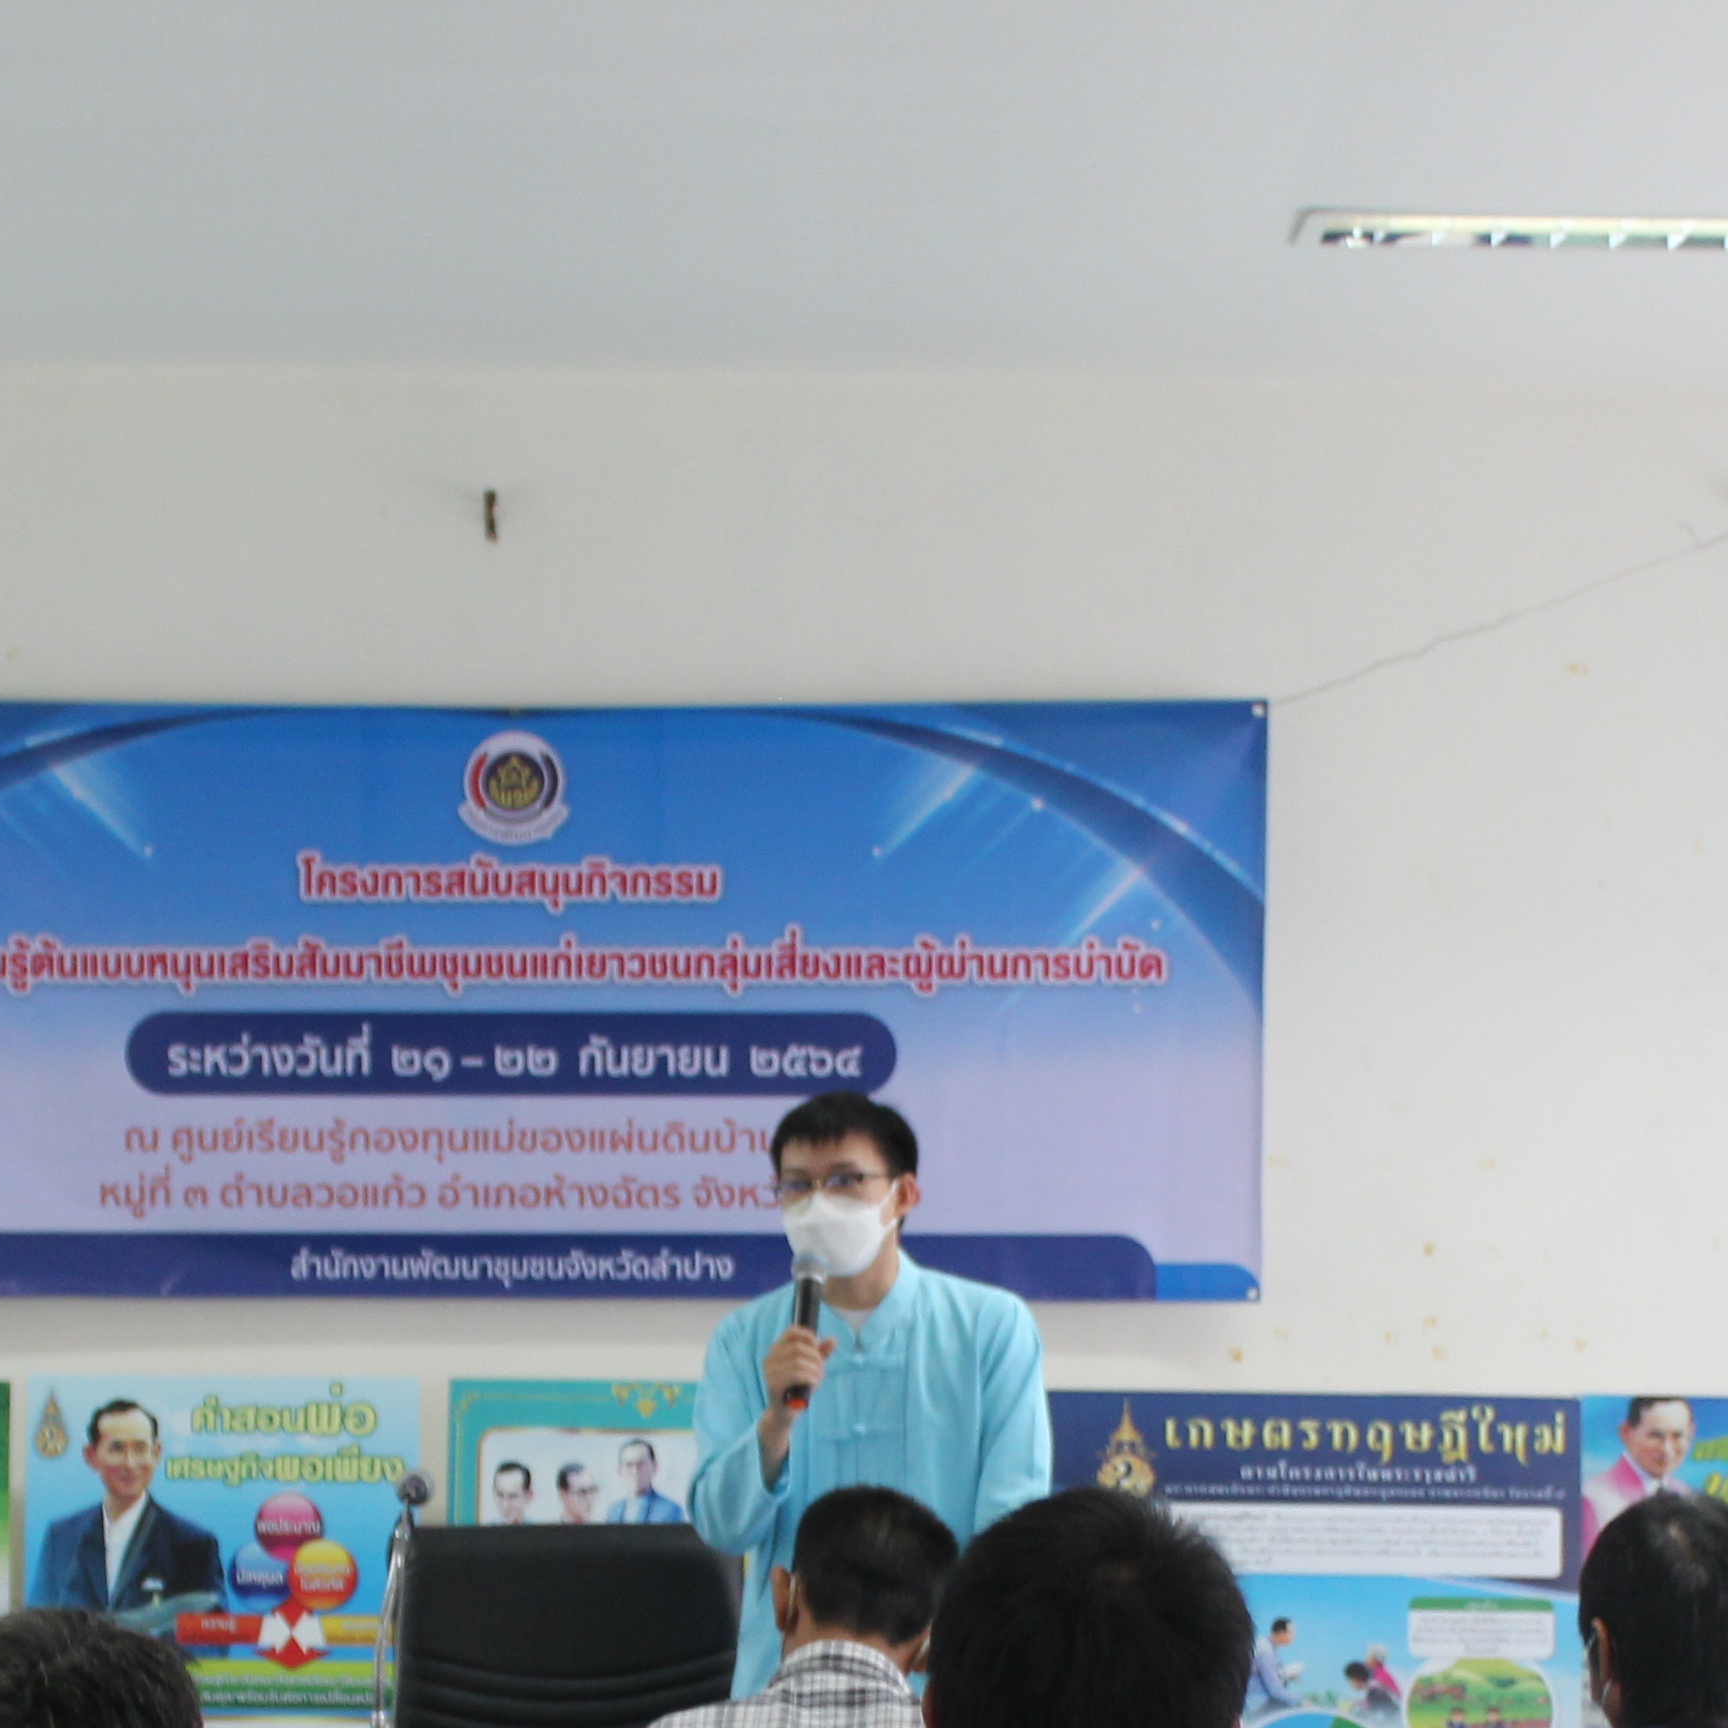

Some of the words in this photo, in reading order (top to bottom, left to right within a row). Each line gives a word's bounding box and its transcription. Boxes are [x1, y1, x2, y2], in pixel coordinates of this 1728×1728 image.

[297, 851, 723, 914] โครงการสนับสนุนกิจกรรม
[167, 1023, 371, 1078] ระหว่างวันที่
[578, 1033, 729, 1077] กันยายน
[125, 1127, 159, 1151] ณ
[100, 1164, 171, 1218] หมู่ที่
[438, 1173, 681, 1209] อำเภอห้างฉัตร
[192, 1383, 377, 1436] คำสอนพ่อ
[1164, 1404, 1567, 1465] เกษตรทฤษฎีใหม่
